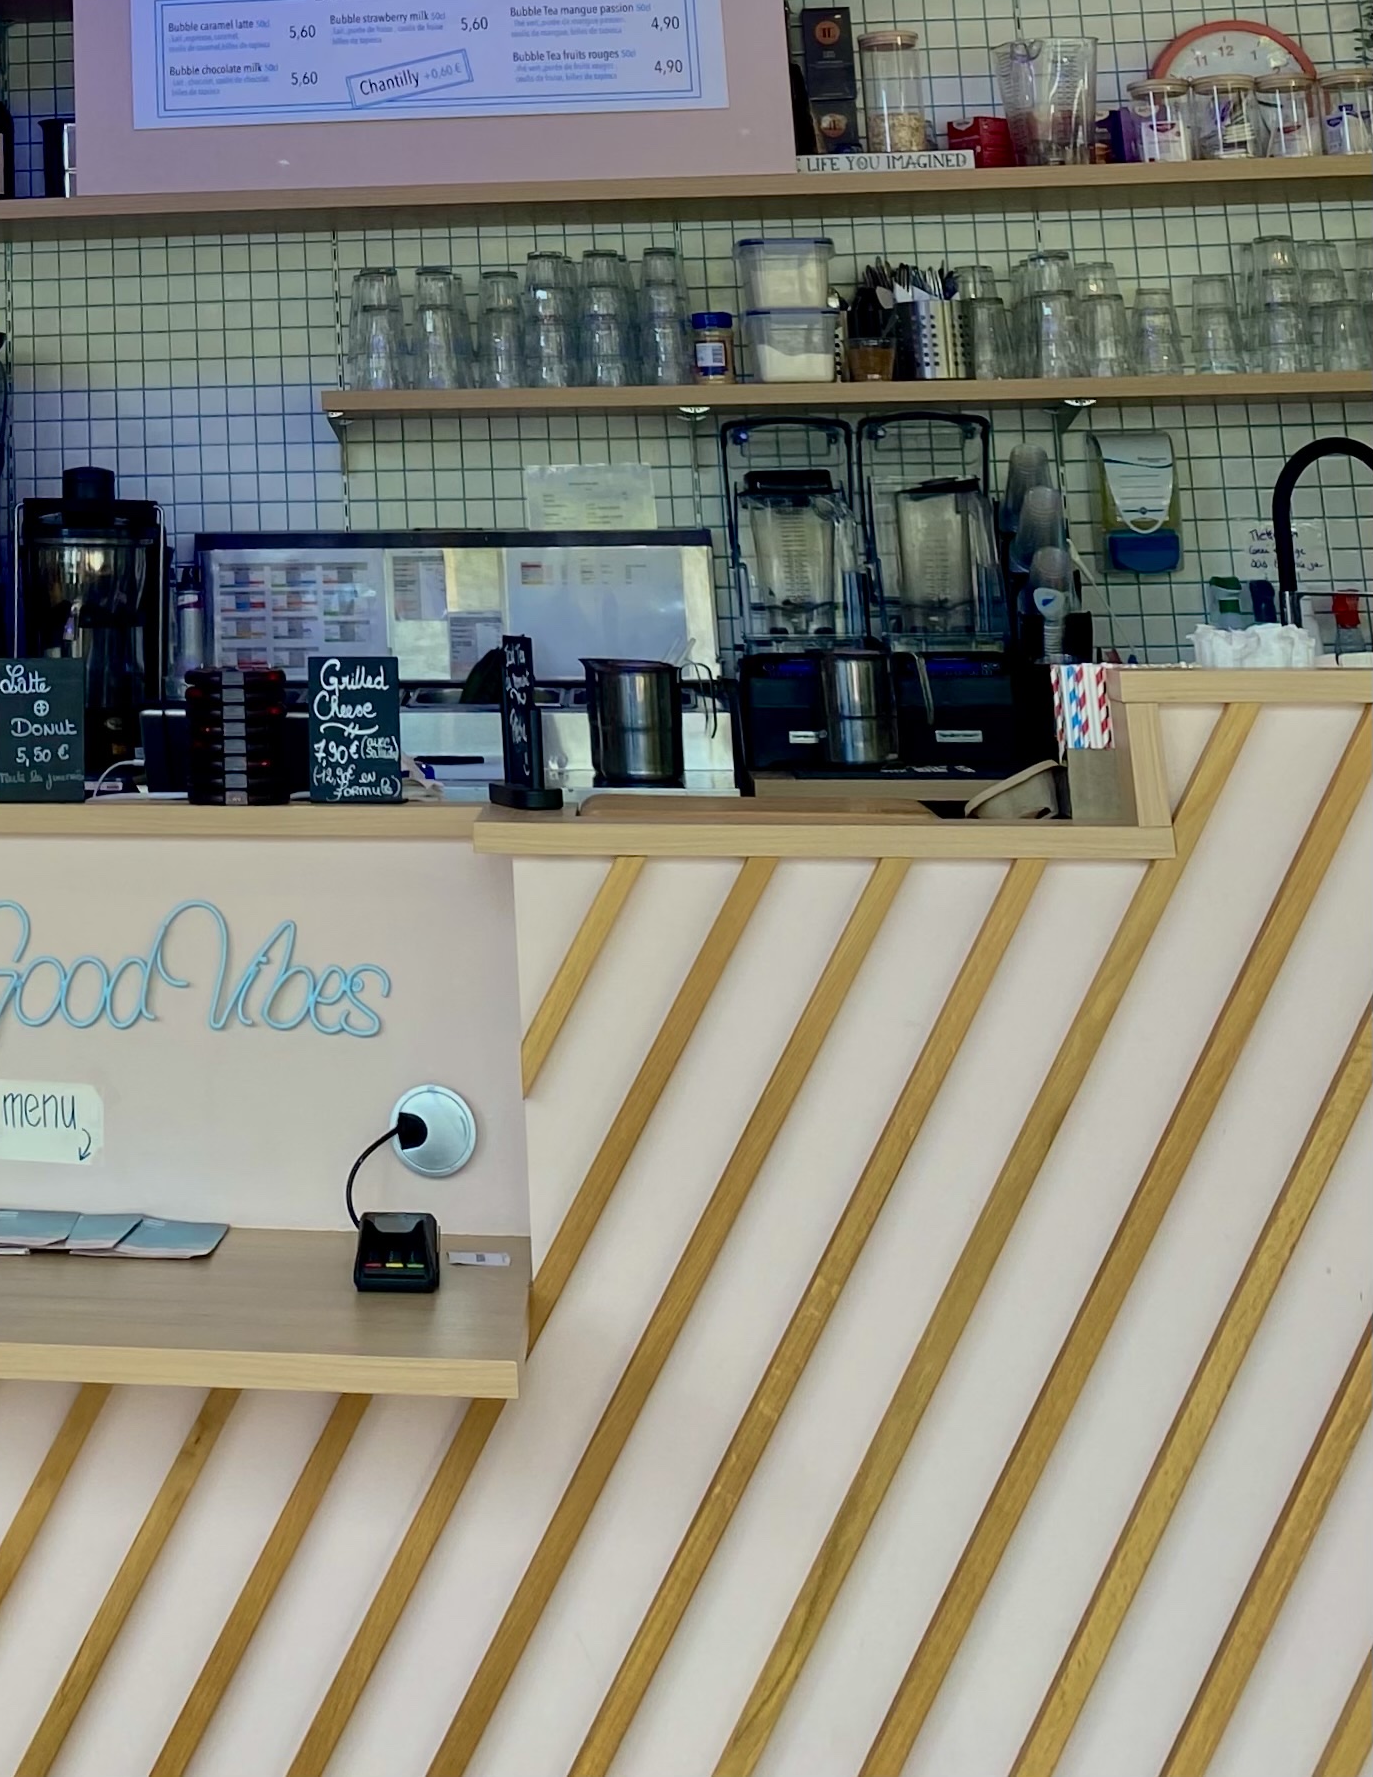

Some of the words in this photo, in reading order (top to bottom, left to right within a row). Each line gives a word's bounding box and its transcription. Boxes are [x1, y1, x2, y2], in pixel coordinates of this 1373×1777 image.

[1194, 55, 1209, 67] 11
[1218, 45, 1235, 57] 12
[359, 69, 418, 95] Chantilly
[806, 157, 840, 172] LIFE
[846, 156, 880, 171] YOU
[886, 153, 967, 170] IMAGINED
[0, 664, 51, 694] Latte
[320, 658, 390, 697] Grilled
[313, 689, 377, 721] Cheese
[16, 746, 51, 767] 5,50
[57, 744, 69, 760] €
[313, 738, 348, 767] 7,90
[349, 740, 360, 760] €
[156, 899, 391, 1038] Vibes
[2, 1090, 77, 1129] menu
